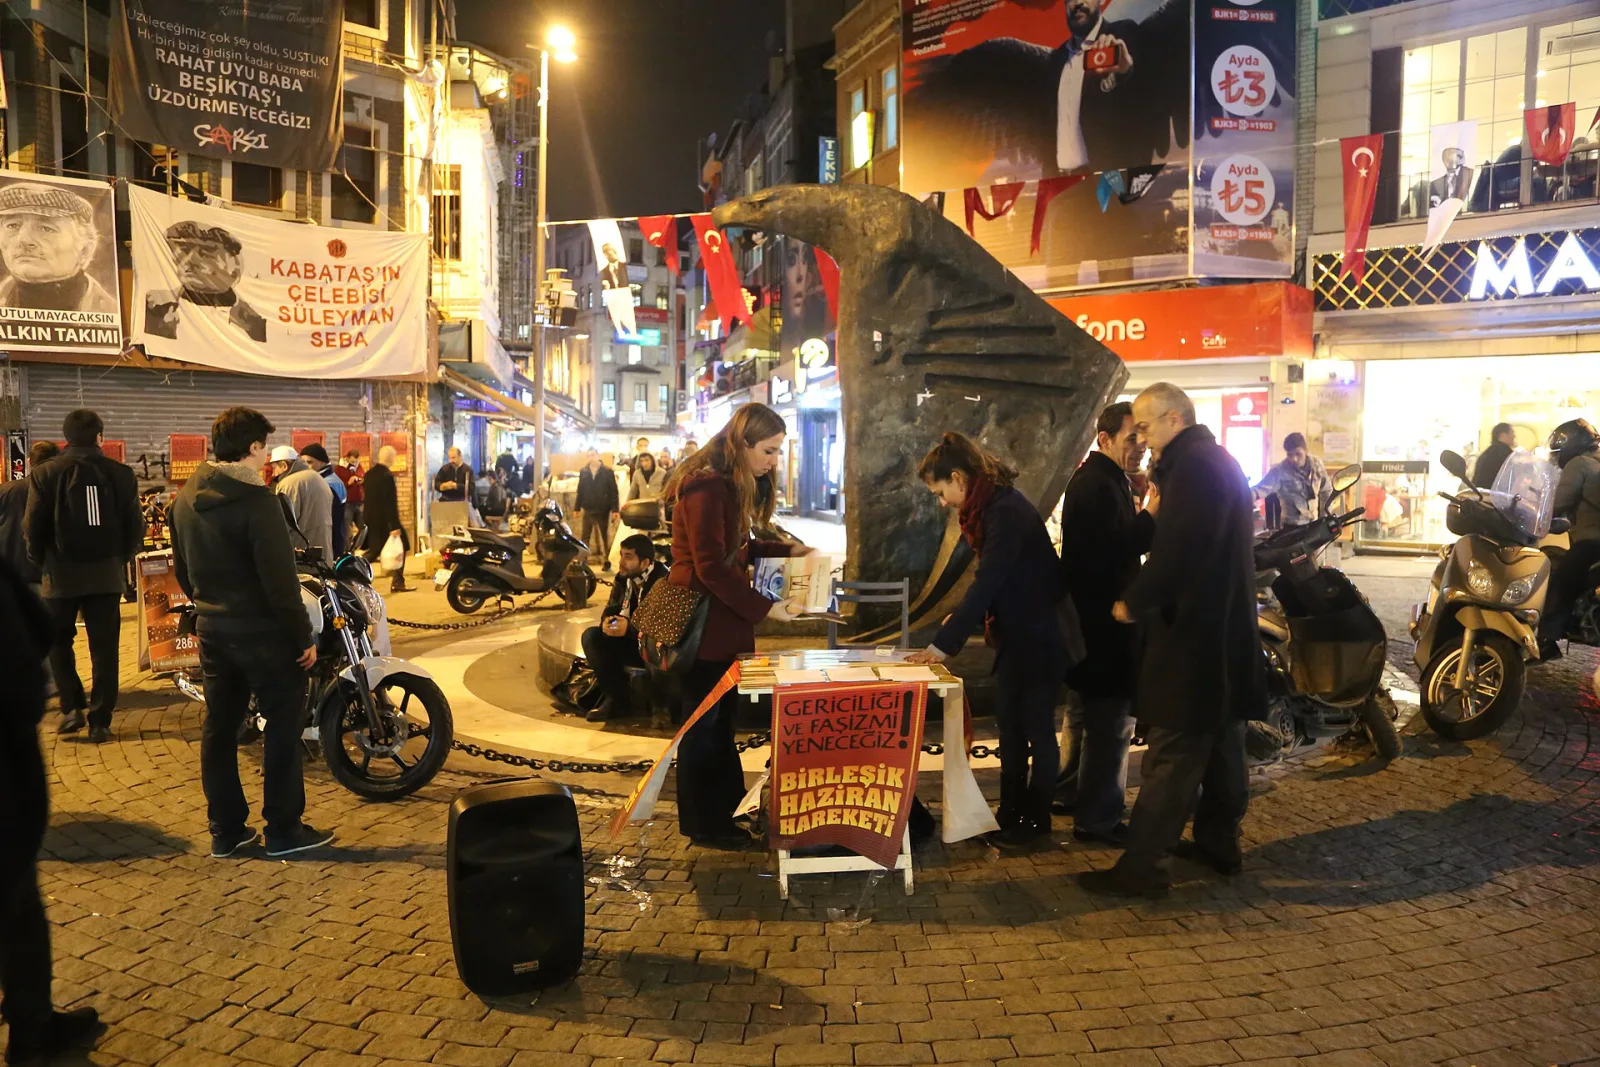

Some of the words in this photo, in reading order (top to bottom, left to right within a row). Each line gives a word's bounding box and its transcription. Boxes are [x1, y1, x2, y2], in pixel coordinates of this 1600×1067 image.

[178, 39, 199, 54] bizi
[202, 47, 242, 61] gidişin
[244, 53, 273, 70] kadar
[276, 63, 320, 79] üzmedi.
[209, 33, 230, 44] çok
[233, 36, 251, 49] şey
[253, 41, 280, 57] oldu,
[282, 48, 329, 66] SUSTUK!
[1228, 53, 1260, 68] Ayda
[155, 47, 215, 73] RAHAT
[219, 61, 255, 80] UYU
[259, 70, 303, 92] BABA
[148, 83, 311, 129] ÜZDÜRMEYECEĞİZ!
[824, 139, 836, 184] TEKN
[1228, 163, 1259, 177] Ayda
[270, 257, 400, 283] KABATAŞ'IN
[1469, 232, 1600, 299] MA
[288, 284, 386, 304] ÇELEBİSİ
[278, 303, 394, 326] SÜLEYMAN
[54, 327, 118, 344] TAKIMI
[310, 331, 368, 348] SEBA
[175, 637, 193, 650] 286
[784, 691, 900, 717] GERİCİLİĞİ
[783, 723, 804, 736] VE
[810, 712, 898, 735] FAŞİZMİ
[780, 763, 905, 792] BİRLEŞİK
[780, 784, 902, 817] HAZİRAN
[780, 808, 896, 838] HAREKETİ
